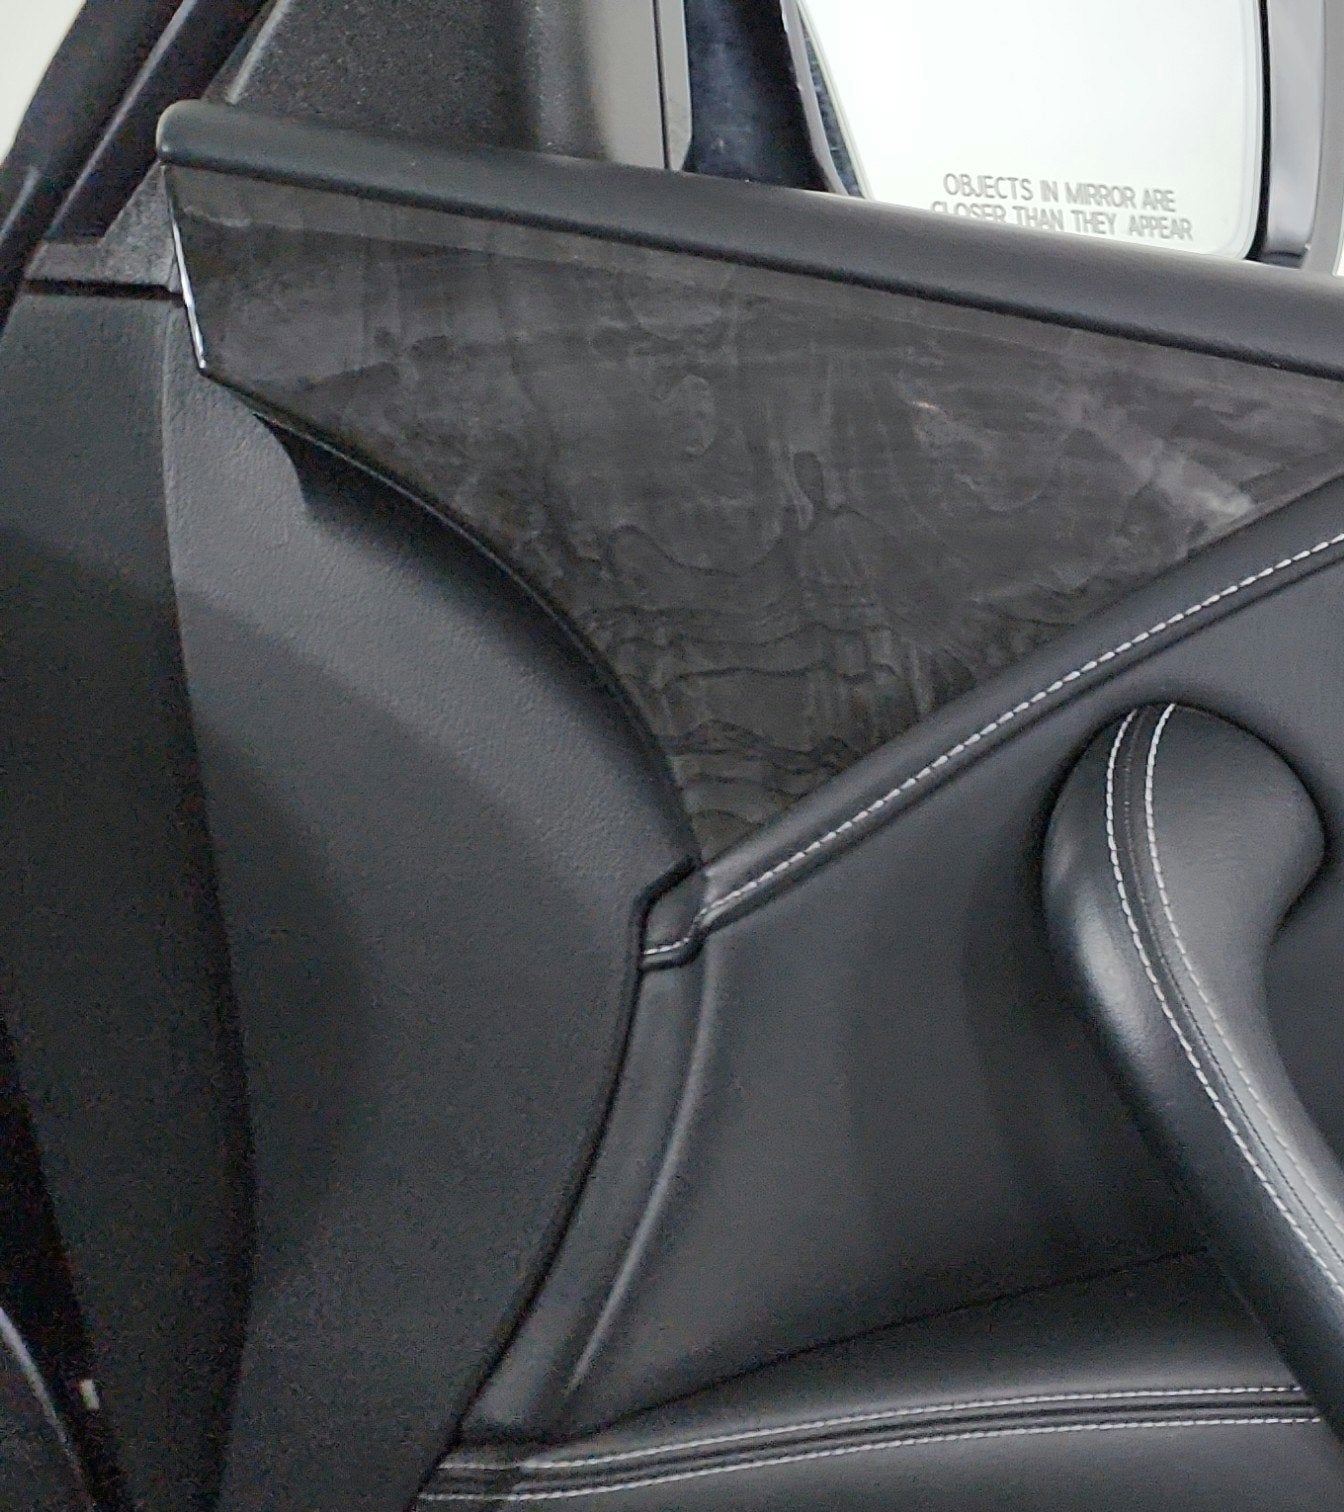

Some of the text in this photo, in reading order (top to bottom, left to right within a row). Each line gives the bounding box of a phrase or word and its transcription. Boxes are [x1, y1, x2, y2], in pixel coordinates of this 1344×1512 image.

[943, 173, 1177, 213] OBJECTS IN MIRROR ARE
[1012, 205, 1064, 230] THAN
[1071, 209, 1117, 234] THEY
[1128, 215, 1193, 241] APPEAR
